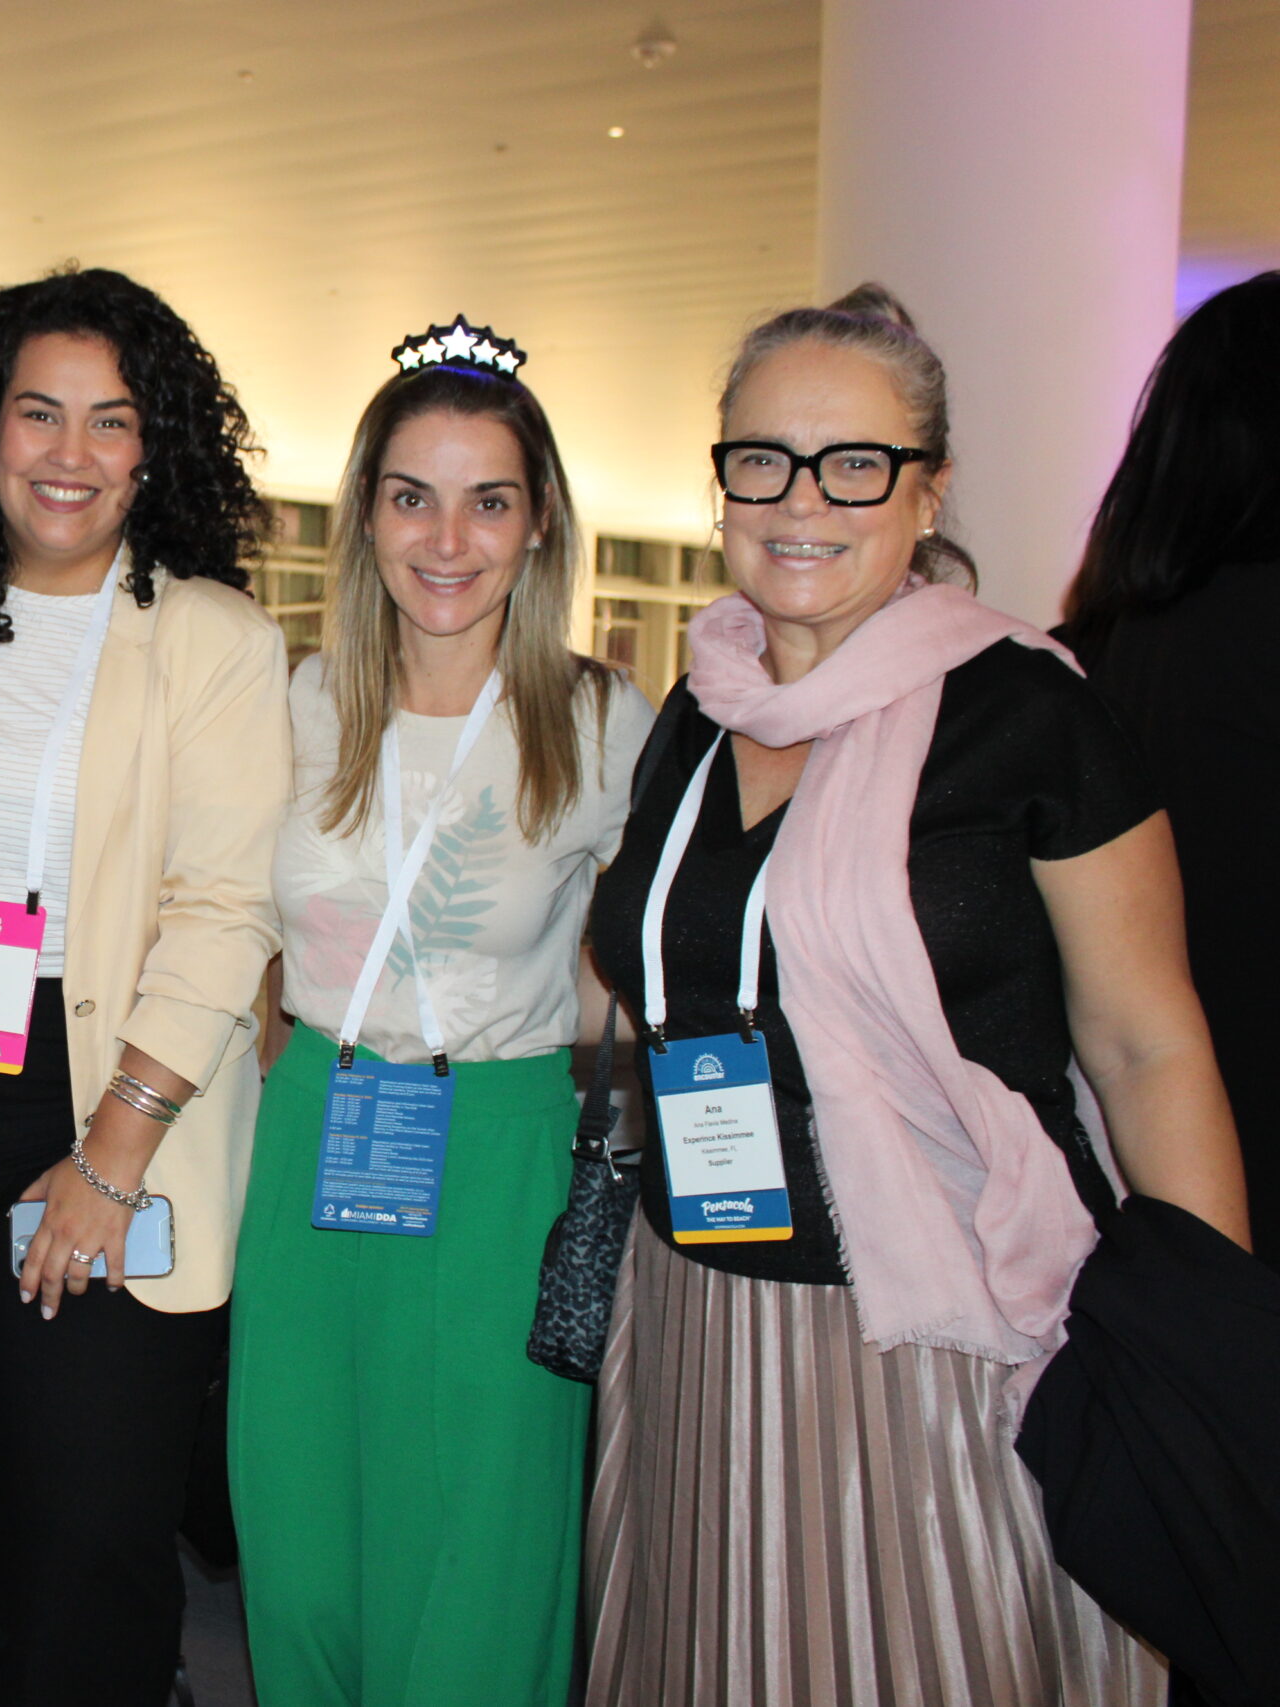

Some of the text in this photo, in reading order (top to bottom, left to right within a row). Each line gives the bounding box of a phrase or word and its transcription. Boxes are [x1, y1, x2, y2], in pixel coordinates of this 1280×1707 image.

[704, 1104, 723, 1115] Ana
[716, 1130, 755, 1141] Kissimmee
[707, 1158, 733, 1168] Supplier
[700, 1197, 755, 1217] Pensacola
